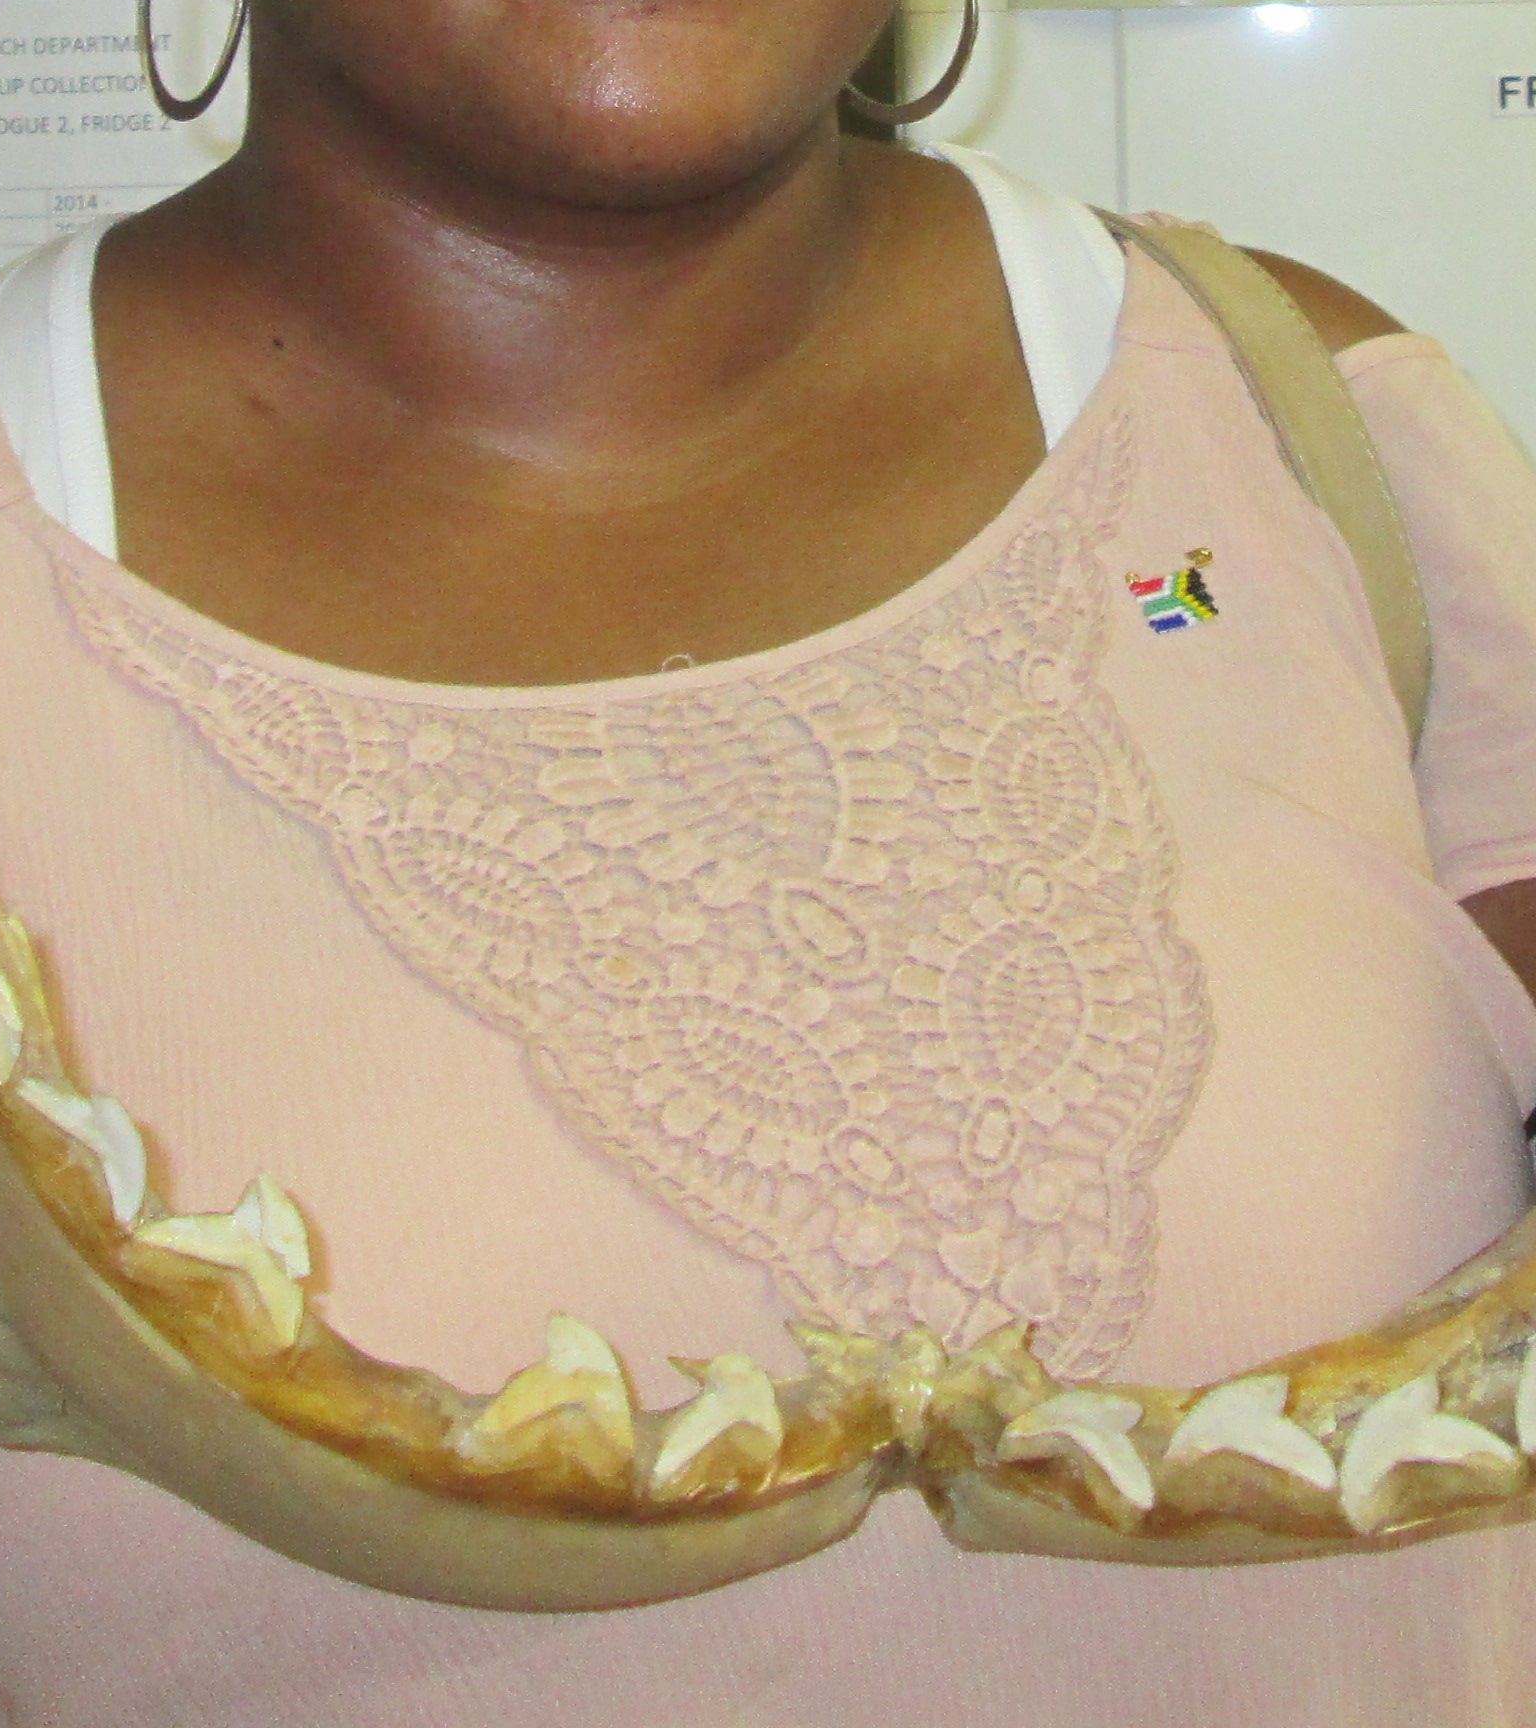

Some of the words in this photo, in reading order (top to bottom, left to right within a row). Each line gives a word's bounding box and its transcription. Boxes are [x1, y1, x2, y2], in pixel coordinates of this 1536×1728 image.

[34, 34, 170, 54] DEPARTMT
[58, 117, 74, 135] 2,
[81, 114, 152, 132] FRIDGE
[55, 195, 98, 211] 2014
